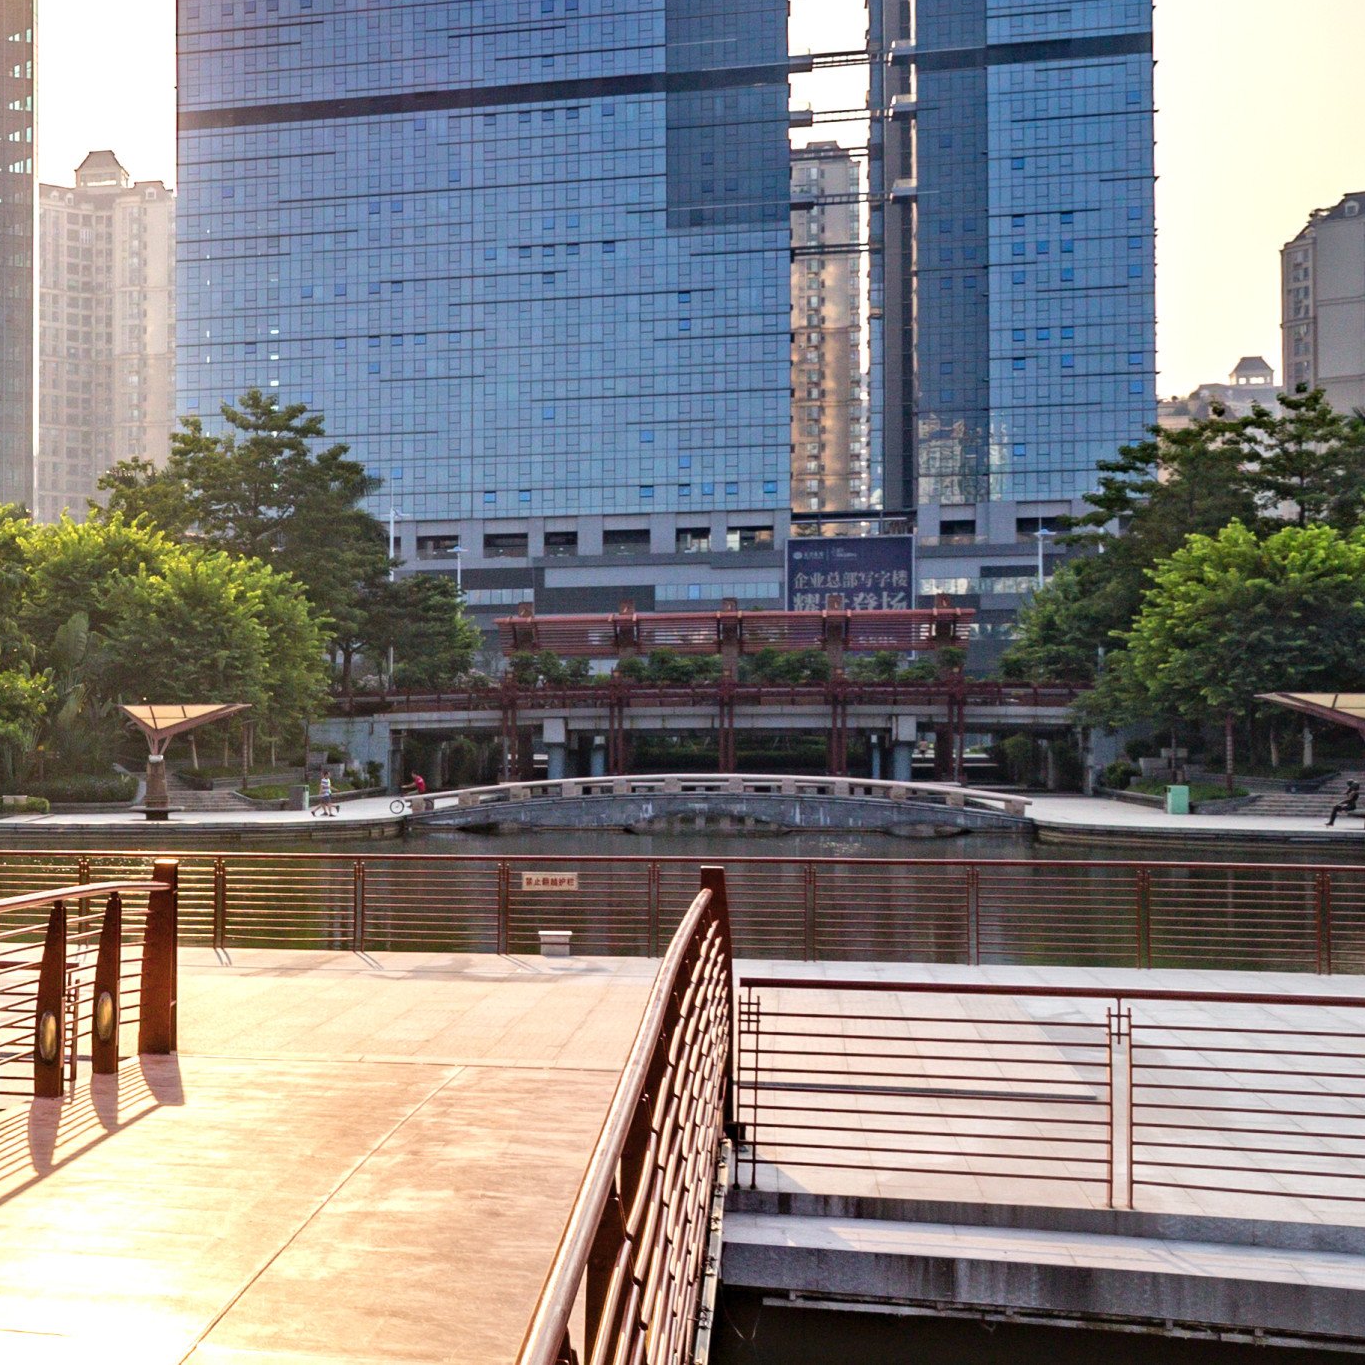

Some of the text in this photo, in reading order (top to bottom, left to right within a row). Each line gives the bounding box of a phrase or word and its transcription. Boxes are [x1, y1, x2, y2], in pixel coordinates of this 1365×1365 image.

[793, 570, 908, 589] 企业总部写字楼
